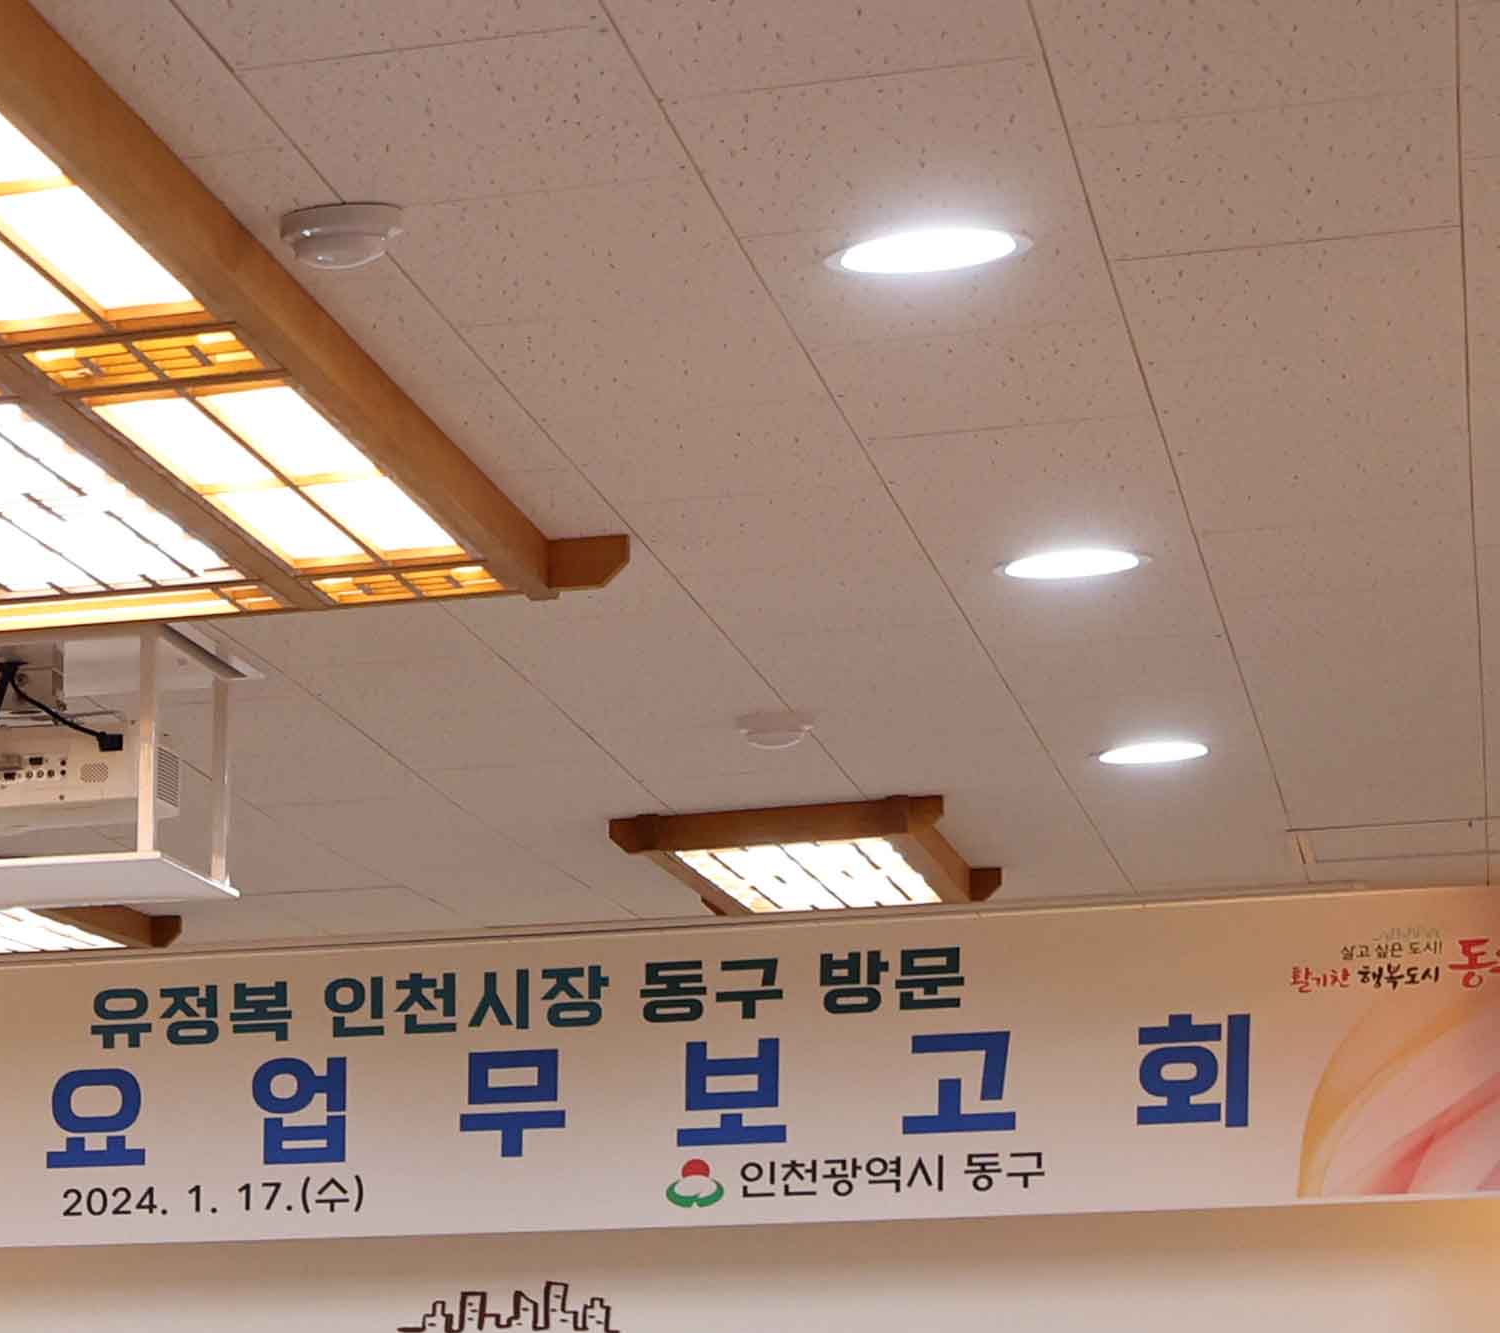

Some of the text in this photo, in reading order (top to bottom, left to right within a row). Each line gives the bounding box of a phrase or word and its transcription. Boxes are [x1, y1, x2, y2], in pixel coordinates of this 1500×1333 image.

[1290, 937, 1500, 993] 활기찬 행복도시 동
[1340, 941, 1371, 961] 살고
[1375, 939, 1404, 959] 싶은
[90, 946, 965, 1048] 유정복 인천시장 동구 방문
[62, 1174, 365, 1217] 2024. 1. 17.(수)
[739, 1151, 1046, 1199] 인천광역시 동구
